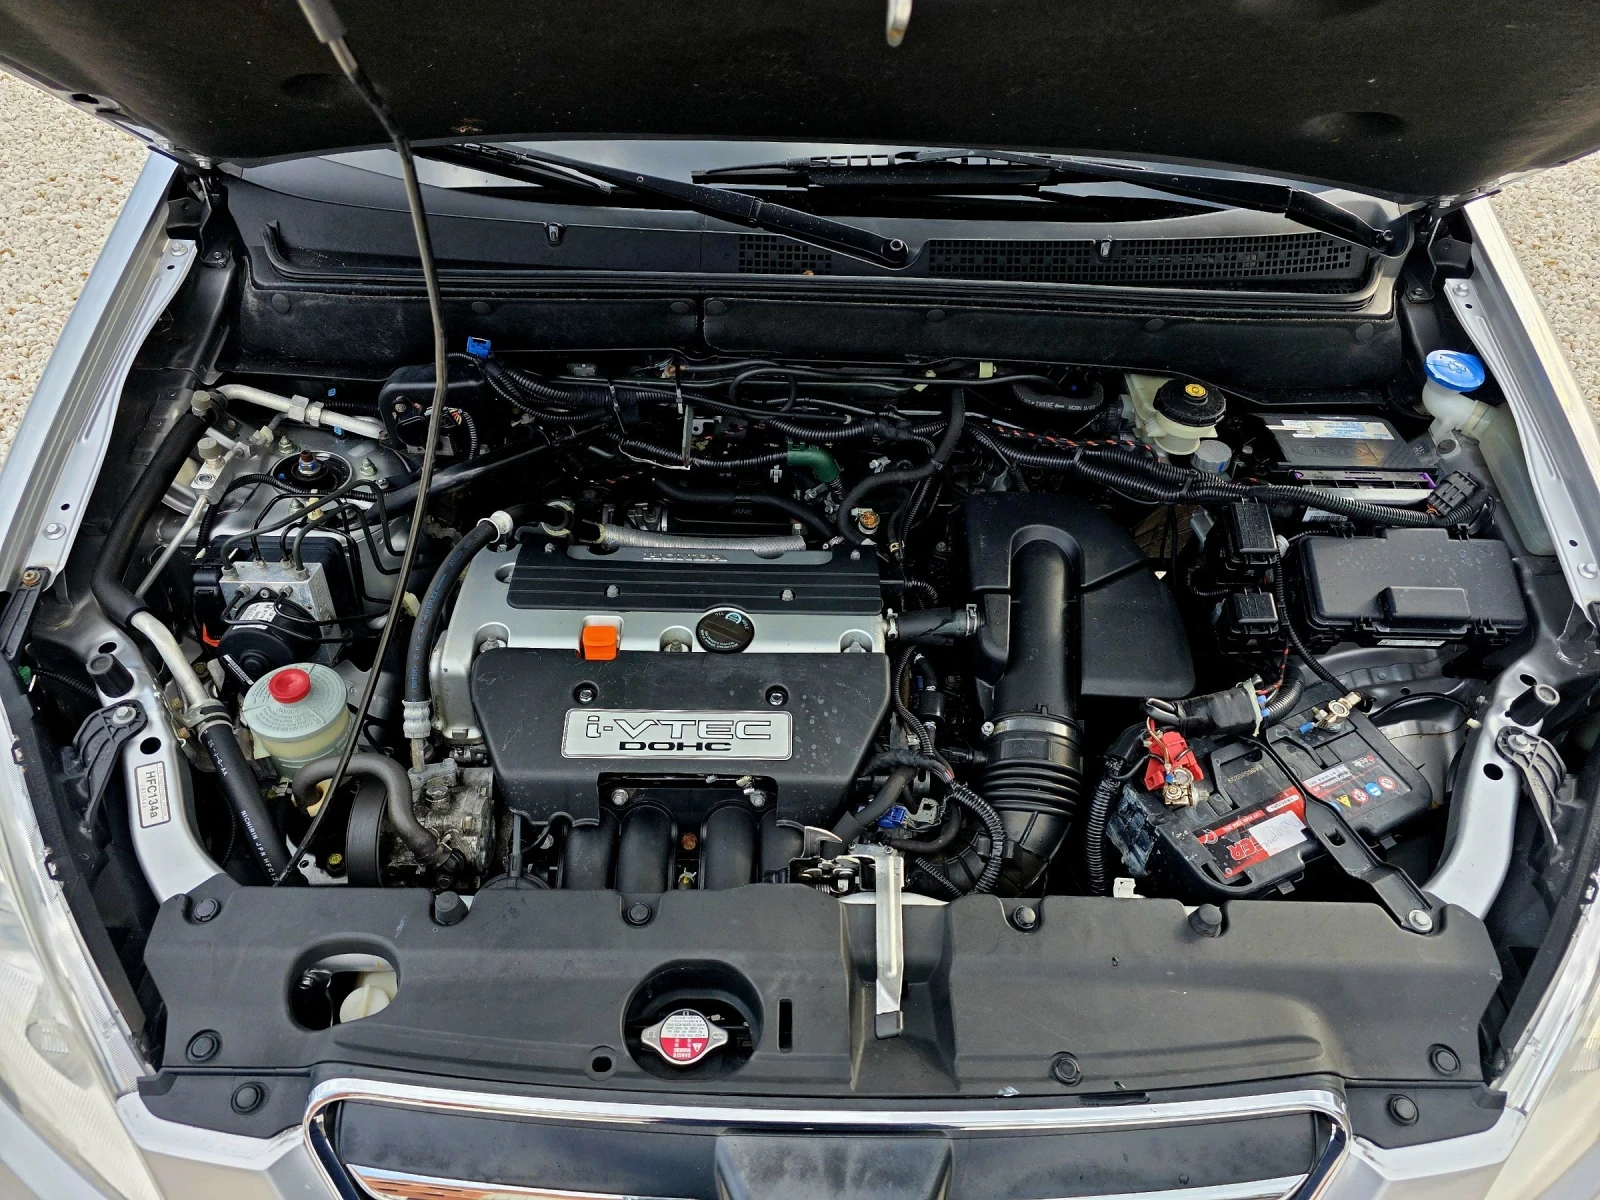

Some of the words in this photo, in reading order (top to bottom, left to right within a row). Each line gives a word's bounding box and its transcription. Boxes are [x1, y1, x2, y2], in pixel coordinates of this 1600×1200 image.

[643, 552, 727, 561] HONDA
[585, 714, 772, 740] i-VTEC
[619, 741, 732, 751] DOHC
[145, 770, 159, 818] HFC134a
[239, 809, 258, 840] NICHIRIN
